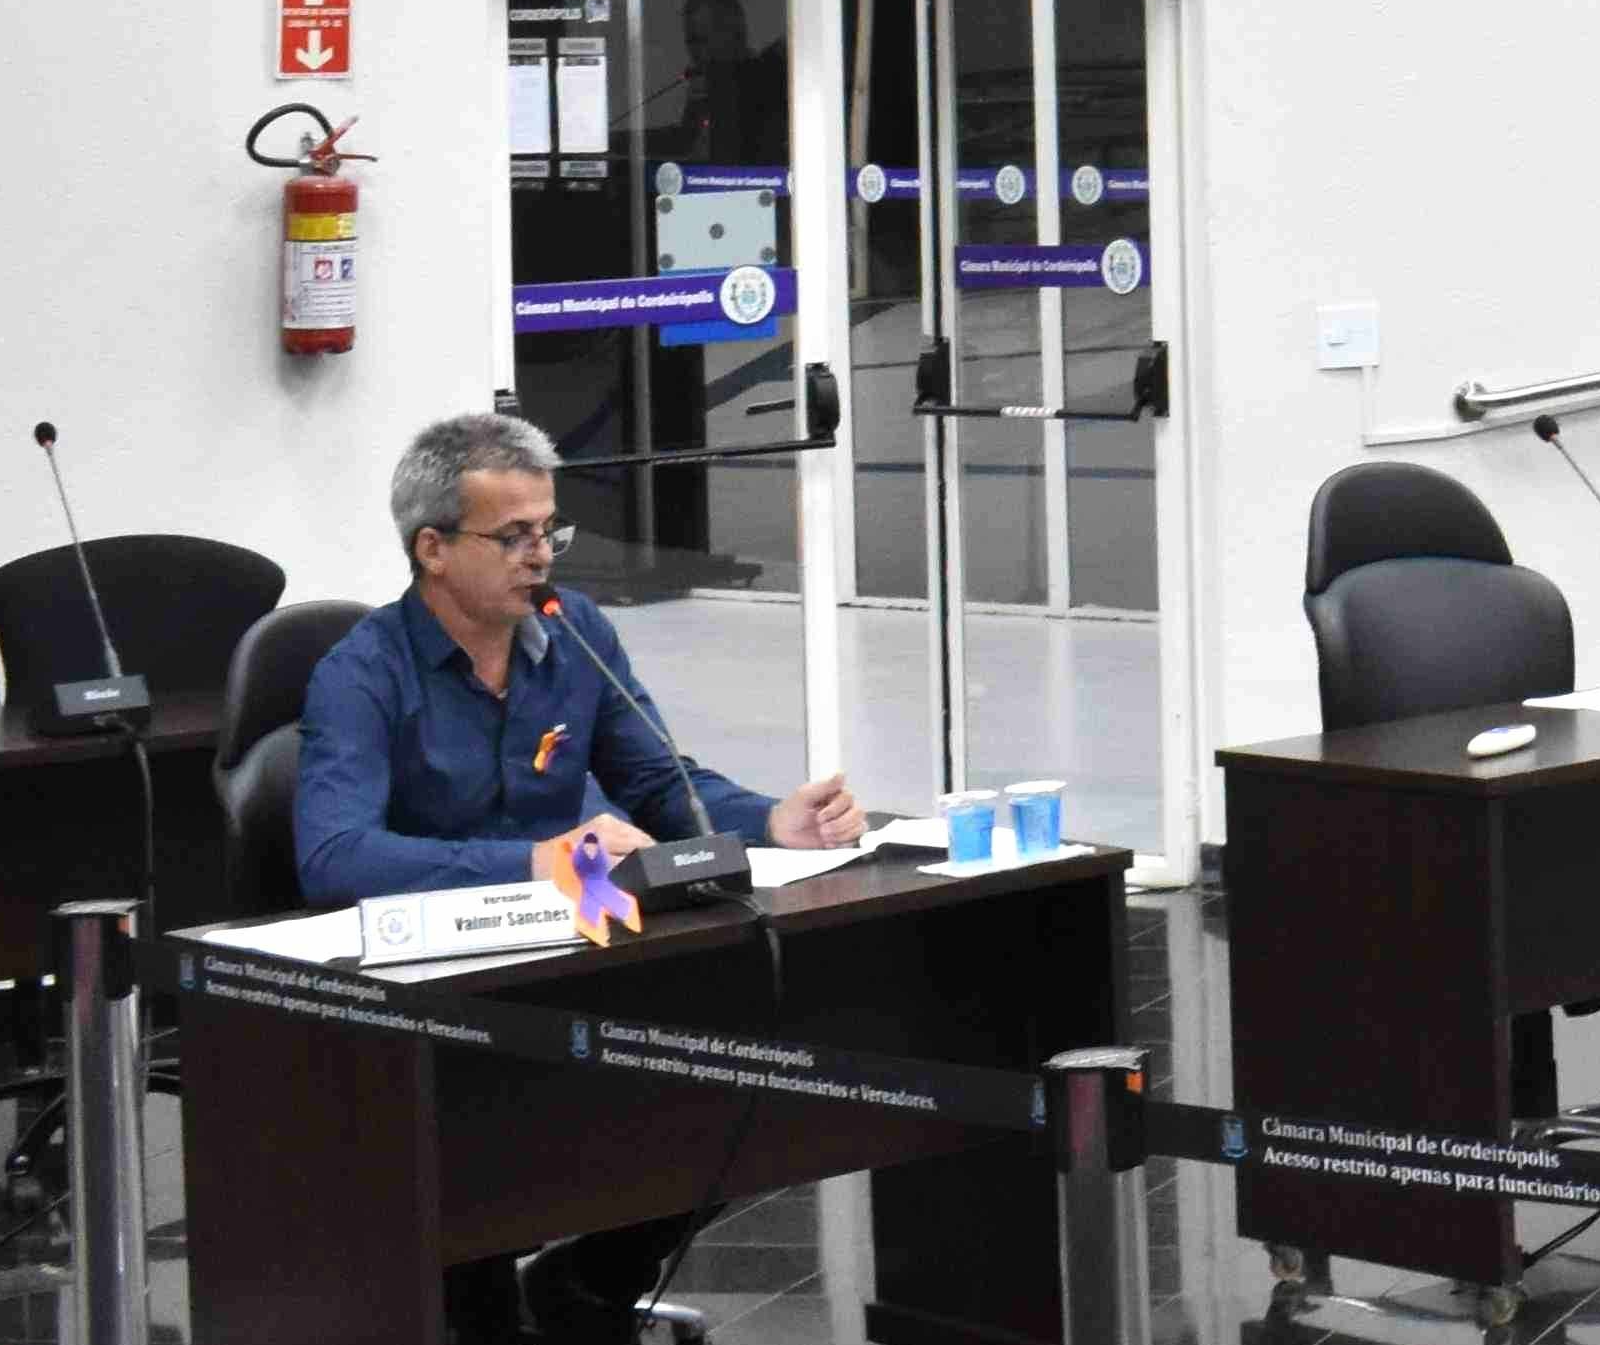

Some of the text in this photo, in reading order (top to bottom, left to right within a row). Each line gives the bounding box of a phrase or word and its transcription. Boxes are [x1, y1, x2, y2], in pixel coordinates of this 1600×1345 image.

[516, 290, 714, 315] Câmara Municipal de Cordeirópolis
[454, 909, 570, 931] Valmir Sanches
[600, 1022, 814, 1067] Câmara Municipal de Cordeirópolis
[602, 1048, 937, 1110] Acesso restrito apenas para funcionários e Vereadores.
[1262, 1118, 1560, 1168] Câmara Municipal de Cordeirópolis
[1264, 1147, 1320, 1169] Acesso
[1324, 1158, 1387, 1177] restrito
[1391, 1166, 1452, 1185] apenas
[1455, 1173, 1494, 1190] para
